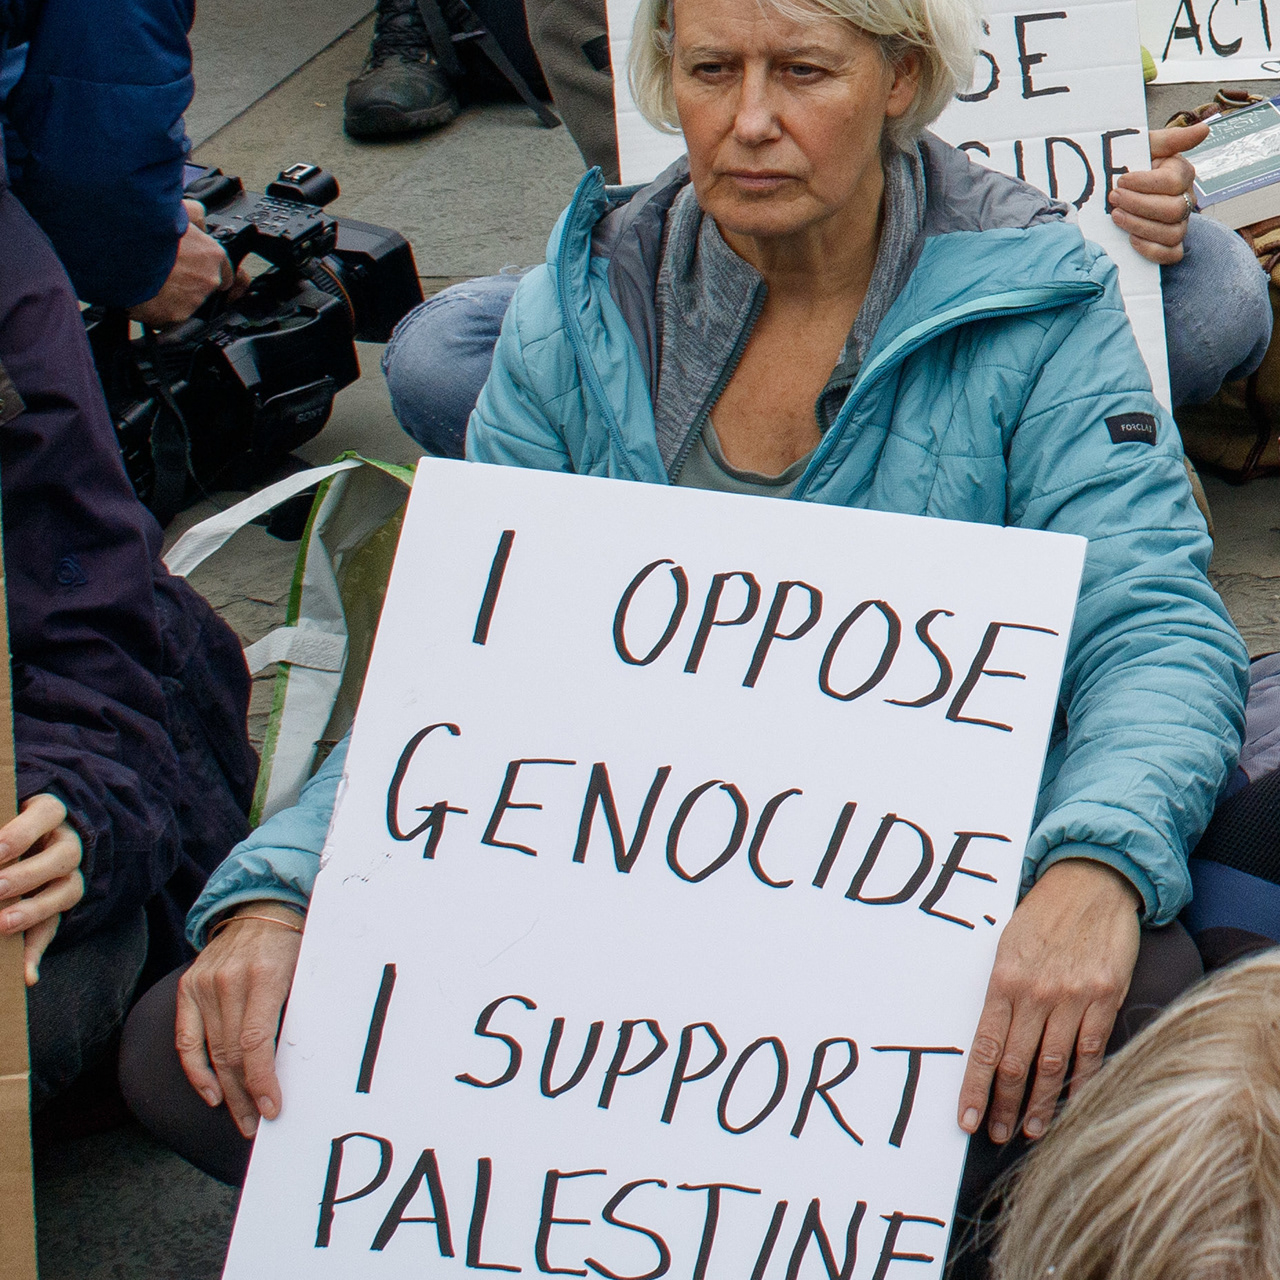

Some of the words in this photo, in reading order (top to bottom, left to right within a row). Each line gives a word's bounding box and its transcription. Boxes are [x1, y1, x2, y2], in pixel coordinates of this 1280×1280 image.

[472, 529, 516, 646] I
[612, 558, 1059, 732] OPPOSE
[356, 962, 397, 1094] I
[454, 994, 964, 1148] SUPPORT
[314, 1131, 946, 1280] PALESTINE
